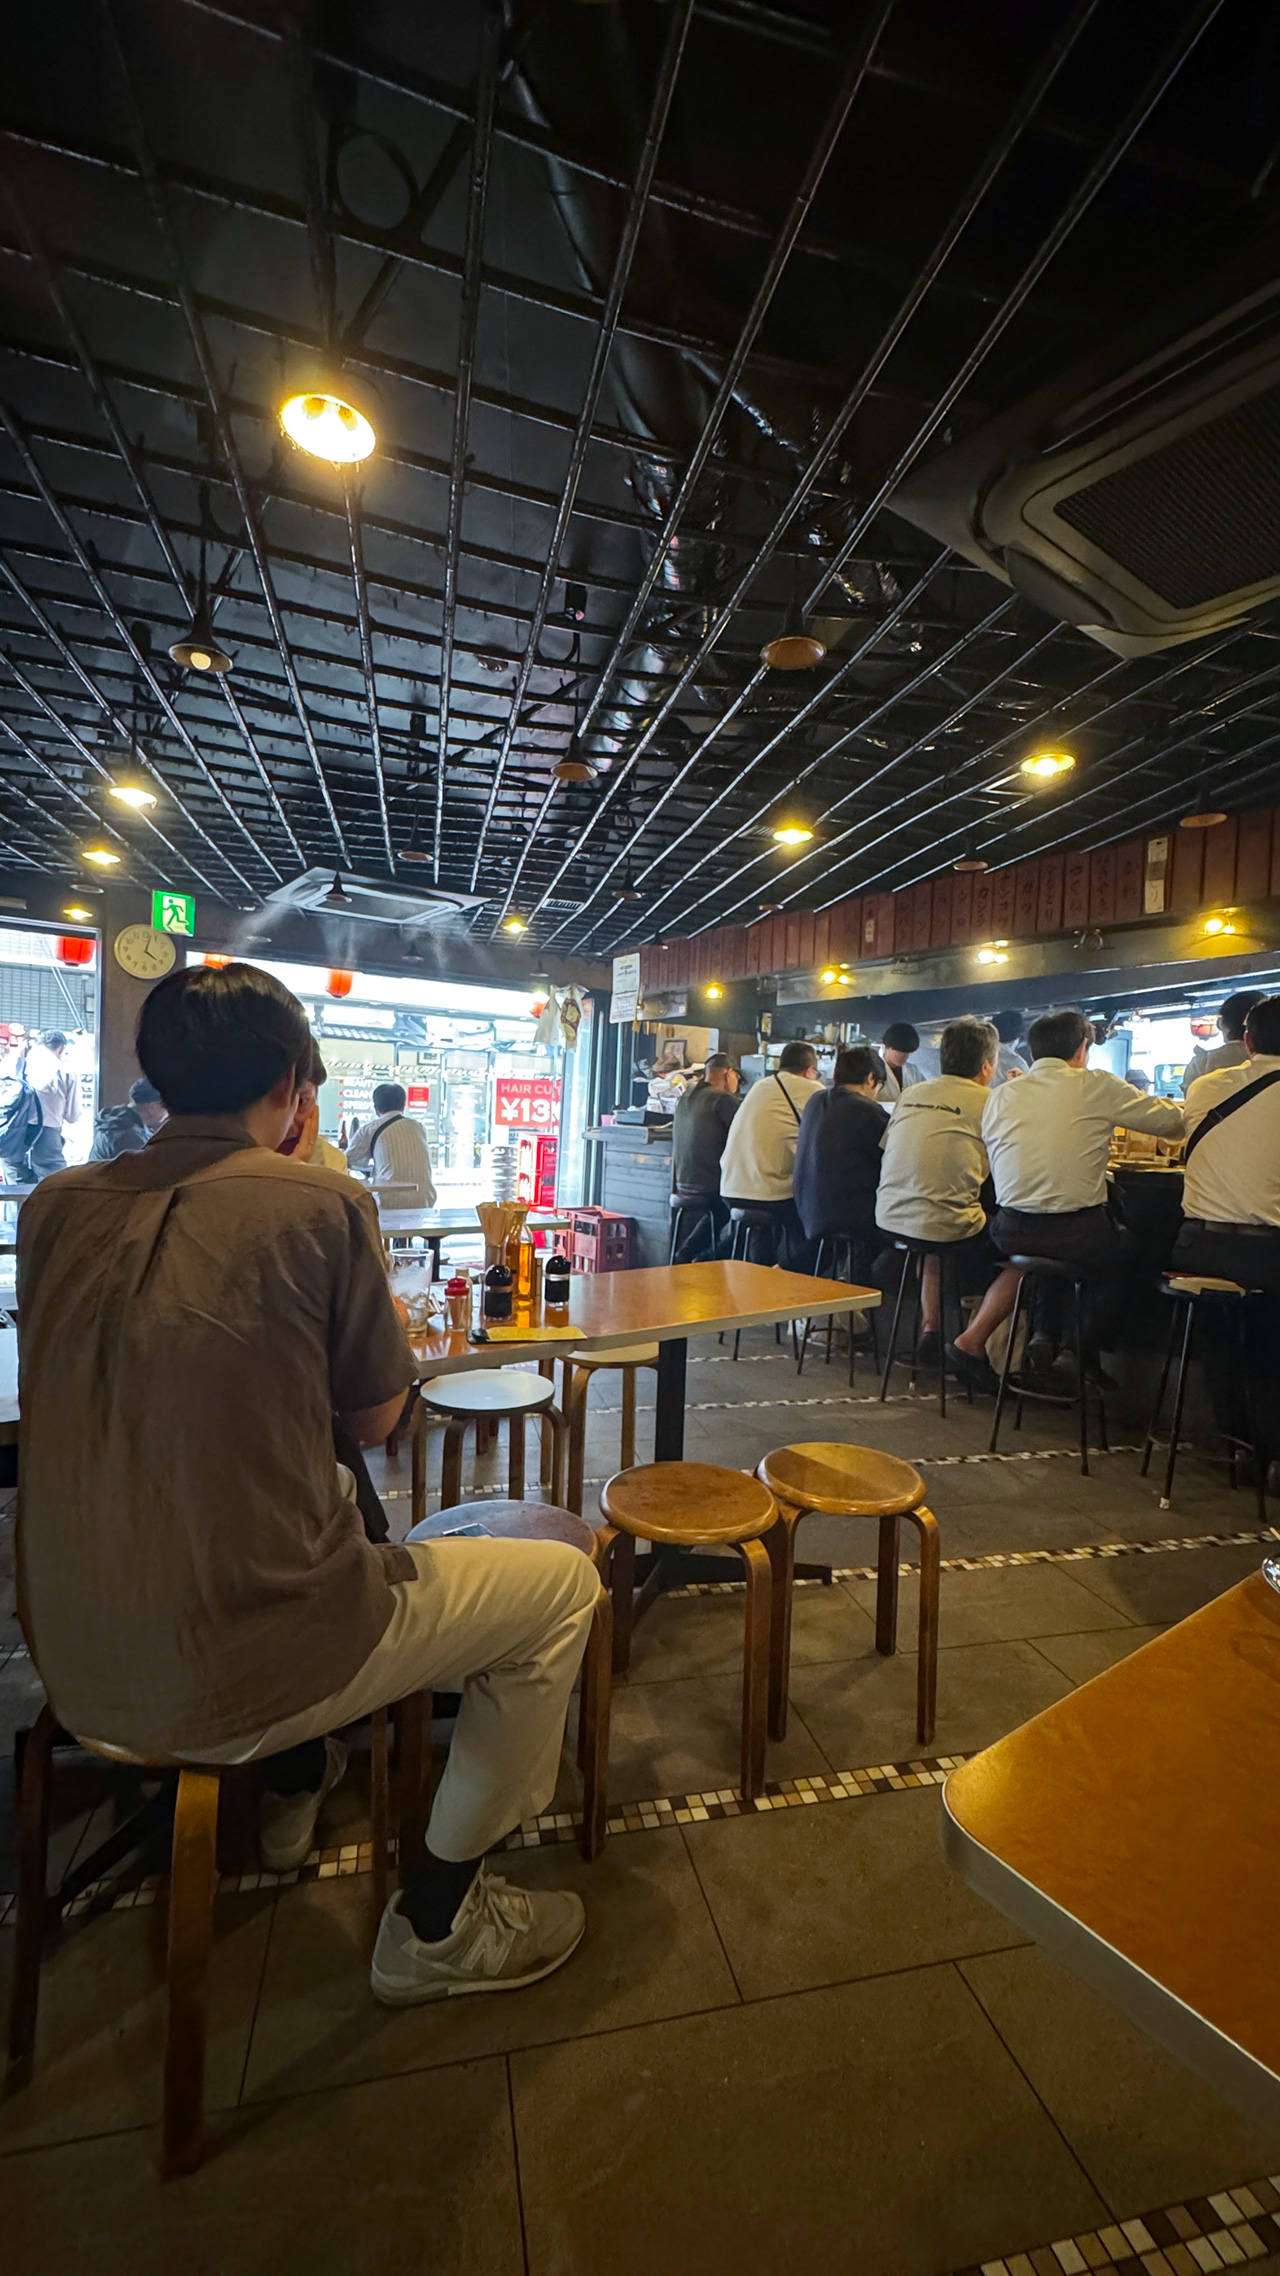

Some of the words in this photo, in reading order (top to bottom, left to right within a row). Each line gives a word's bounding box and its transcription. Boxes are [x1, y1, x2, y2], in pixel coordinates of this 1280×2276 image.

[1069, 865, 1083, 914] つくね
[501, 1083, 532, 1094] HAIR
